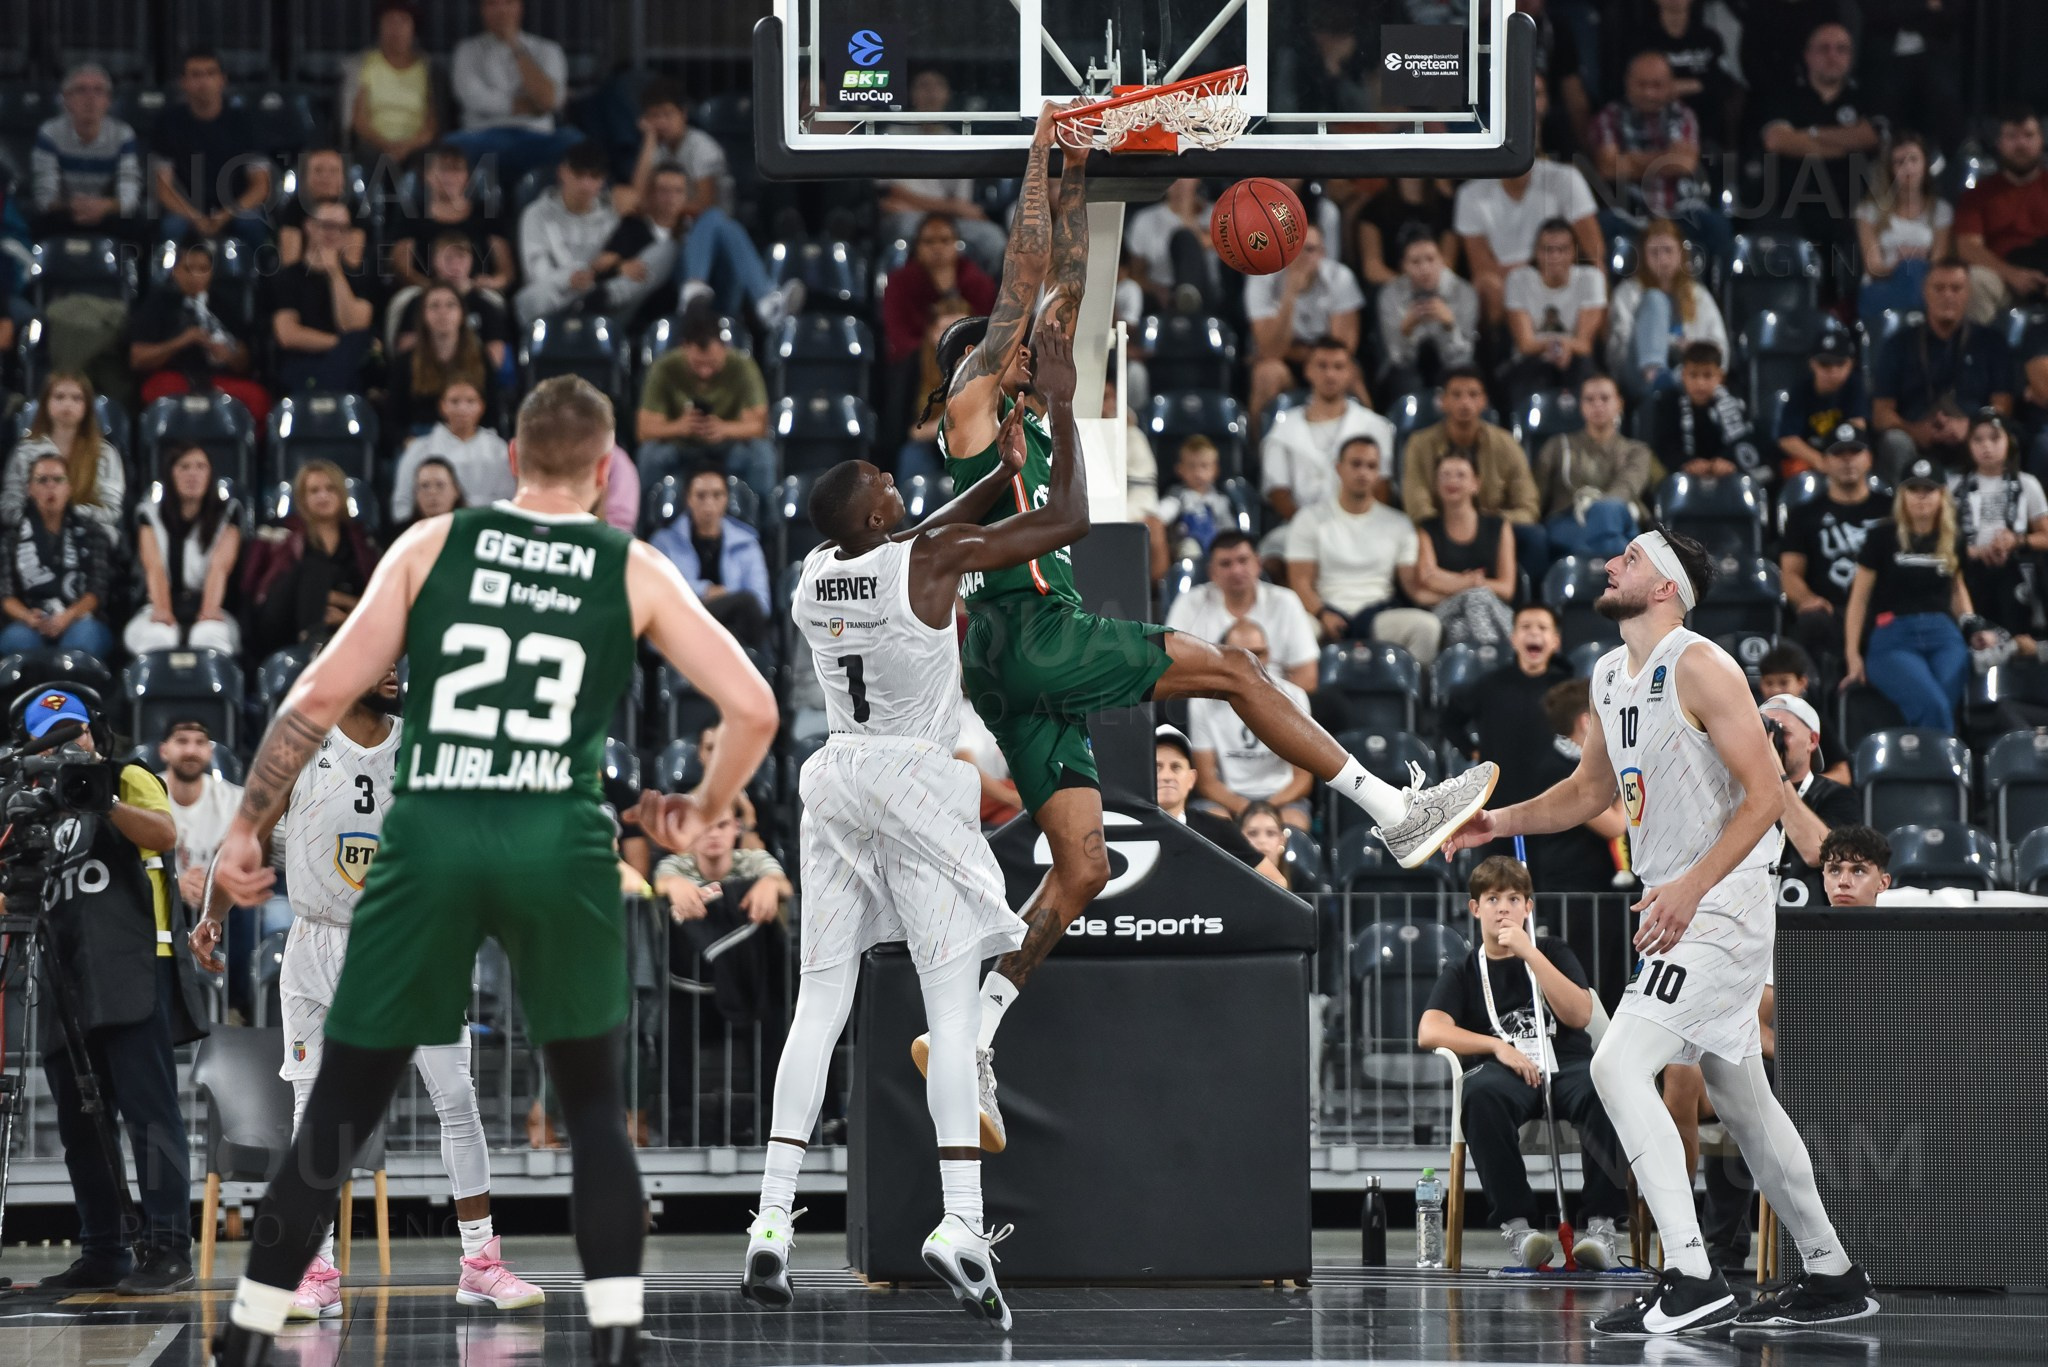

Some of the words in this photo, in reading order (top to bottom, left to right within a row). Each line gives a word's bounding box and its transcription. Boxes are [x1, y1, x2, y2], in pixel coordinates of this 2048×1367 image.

[844, 73, 888, 85] BKT
[1404, 59, 1459, 70] oneteam
[840, 90, 893, 104] EuroCup
[1268, 202, 1296, 252] LEGACY
[475, 528, 597, 581] GEBEN
[510, 582, 582, 614] triglav
[816, 576, 877, 601] HERVEY
[428, 622, 587, 747] 23
[838, 654, 870, 723] 1
[1619, 706, 1639, 749] 10
[354, 774, 375, 814] 3
[345, 845, 375, 865] BT
[41, 859, 110, 911] OTO
[1114, 914, 1224, 941] Sports
[1643, 960, 1687, 1004] 10
